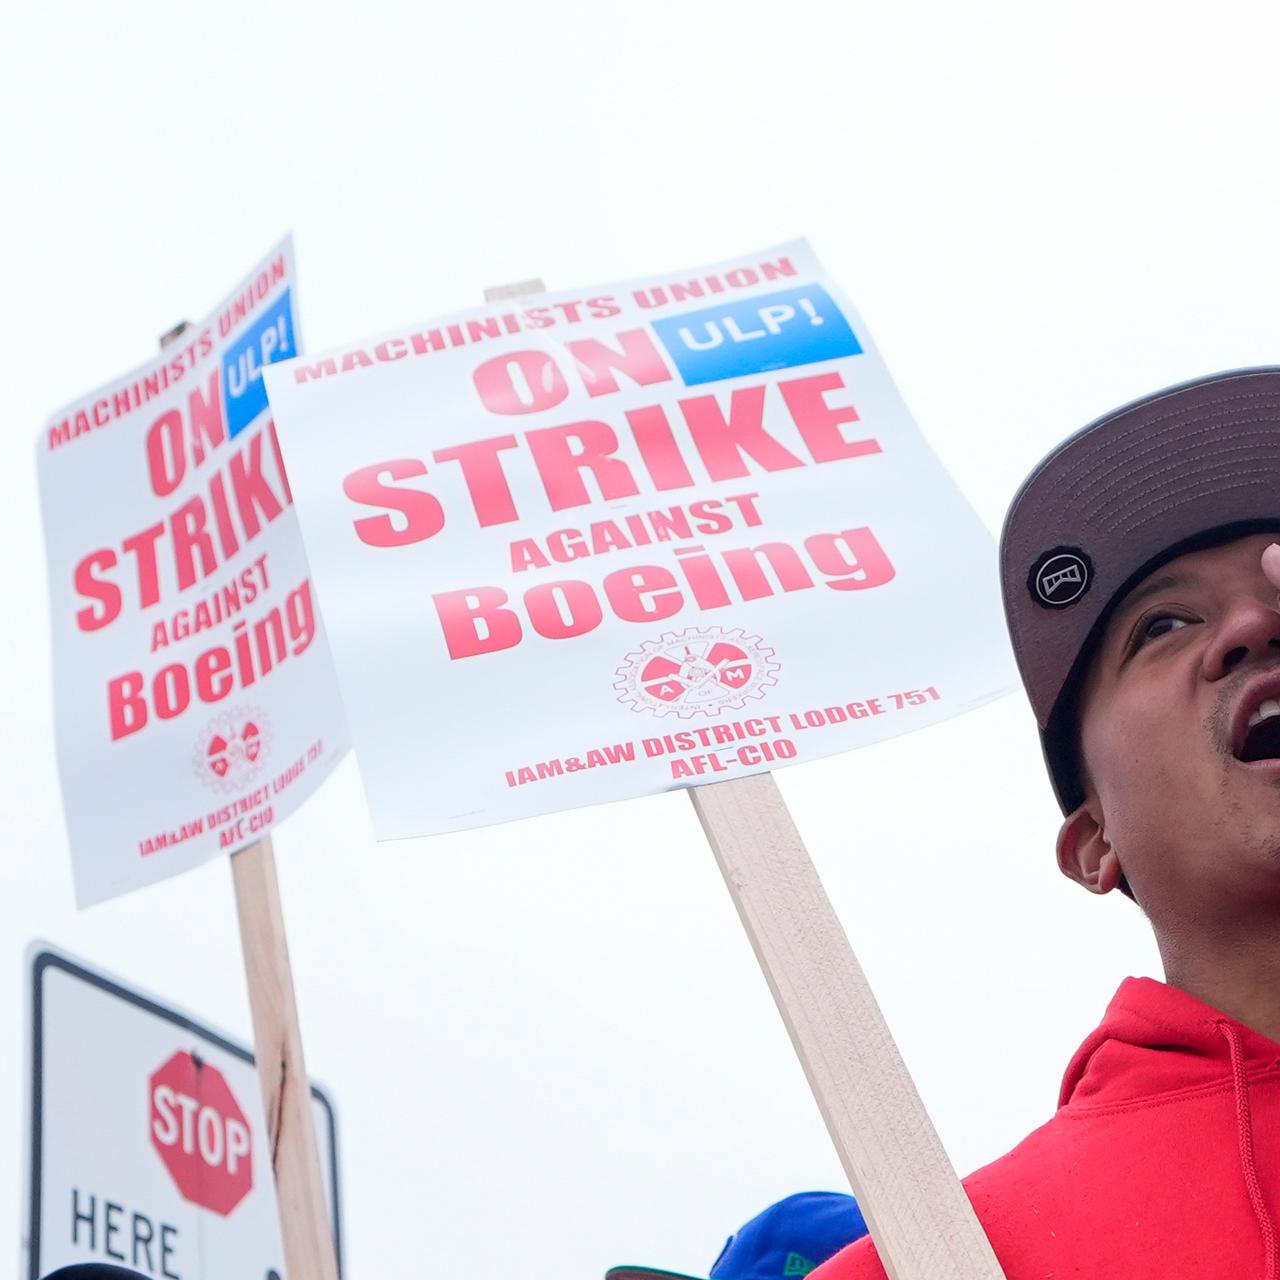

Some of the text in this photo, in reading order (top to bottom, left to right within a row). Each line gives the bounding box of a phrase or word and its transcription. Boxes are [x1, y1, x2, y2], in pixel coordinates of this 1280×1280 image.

[48, 255, 285, 450] MACHINISTS UNION
[228, 314, 288, 397] ULP!
[293, 257, 798, 384] MACHINISTS UNION
[677, 297, 824, 352] ULP!
[472, 327, 673, 416] ON
[145, 366, 226, 498] ON
[342, 371, 883, 549] STRIKE
[509, 492, 763, 573] AGAINST
[150, 553, 271, 653] AGAINST
[432, 526, 897, 661] Boeing
[107, 576, 316, 742] Boeing
[505, 686, 942, 788] IAM&AW DISTRICT LODGE 751
[670, 738, 798, 780] AFL-CIO
[152, 1084, 250, 1175] STOP
